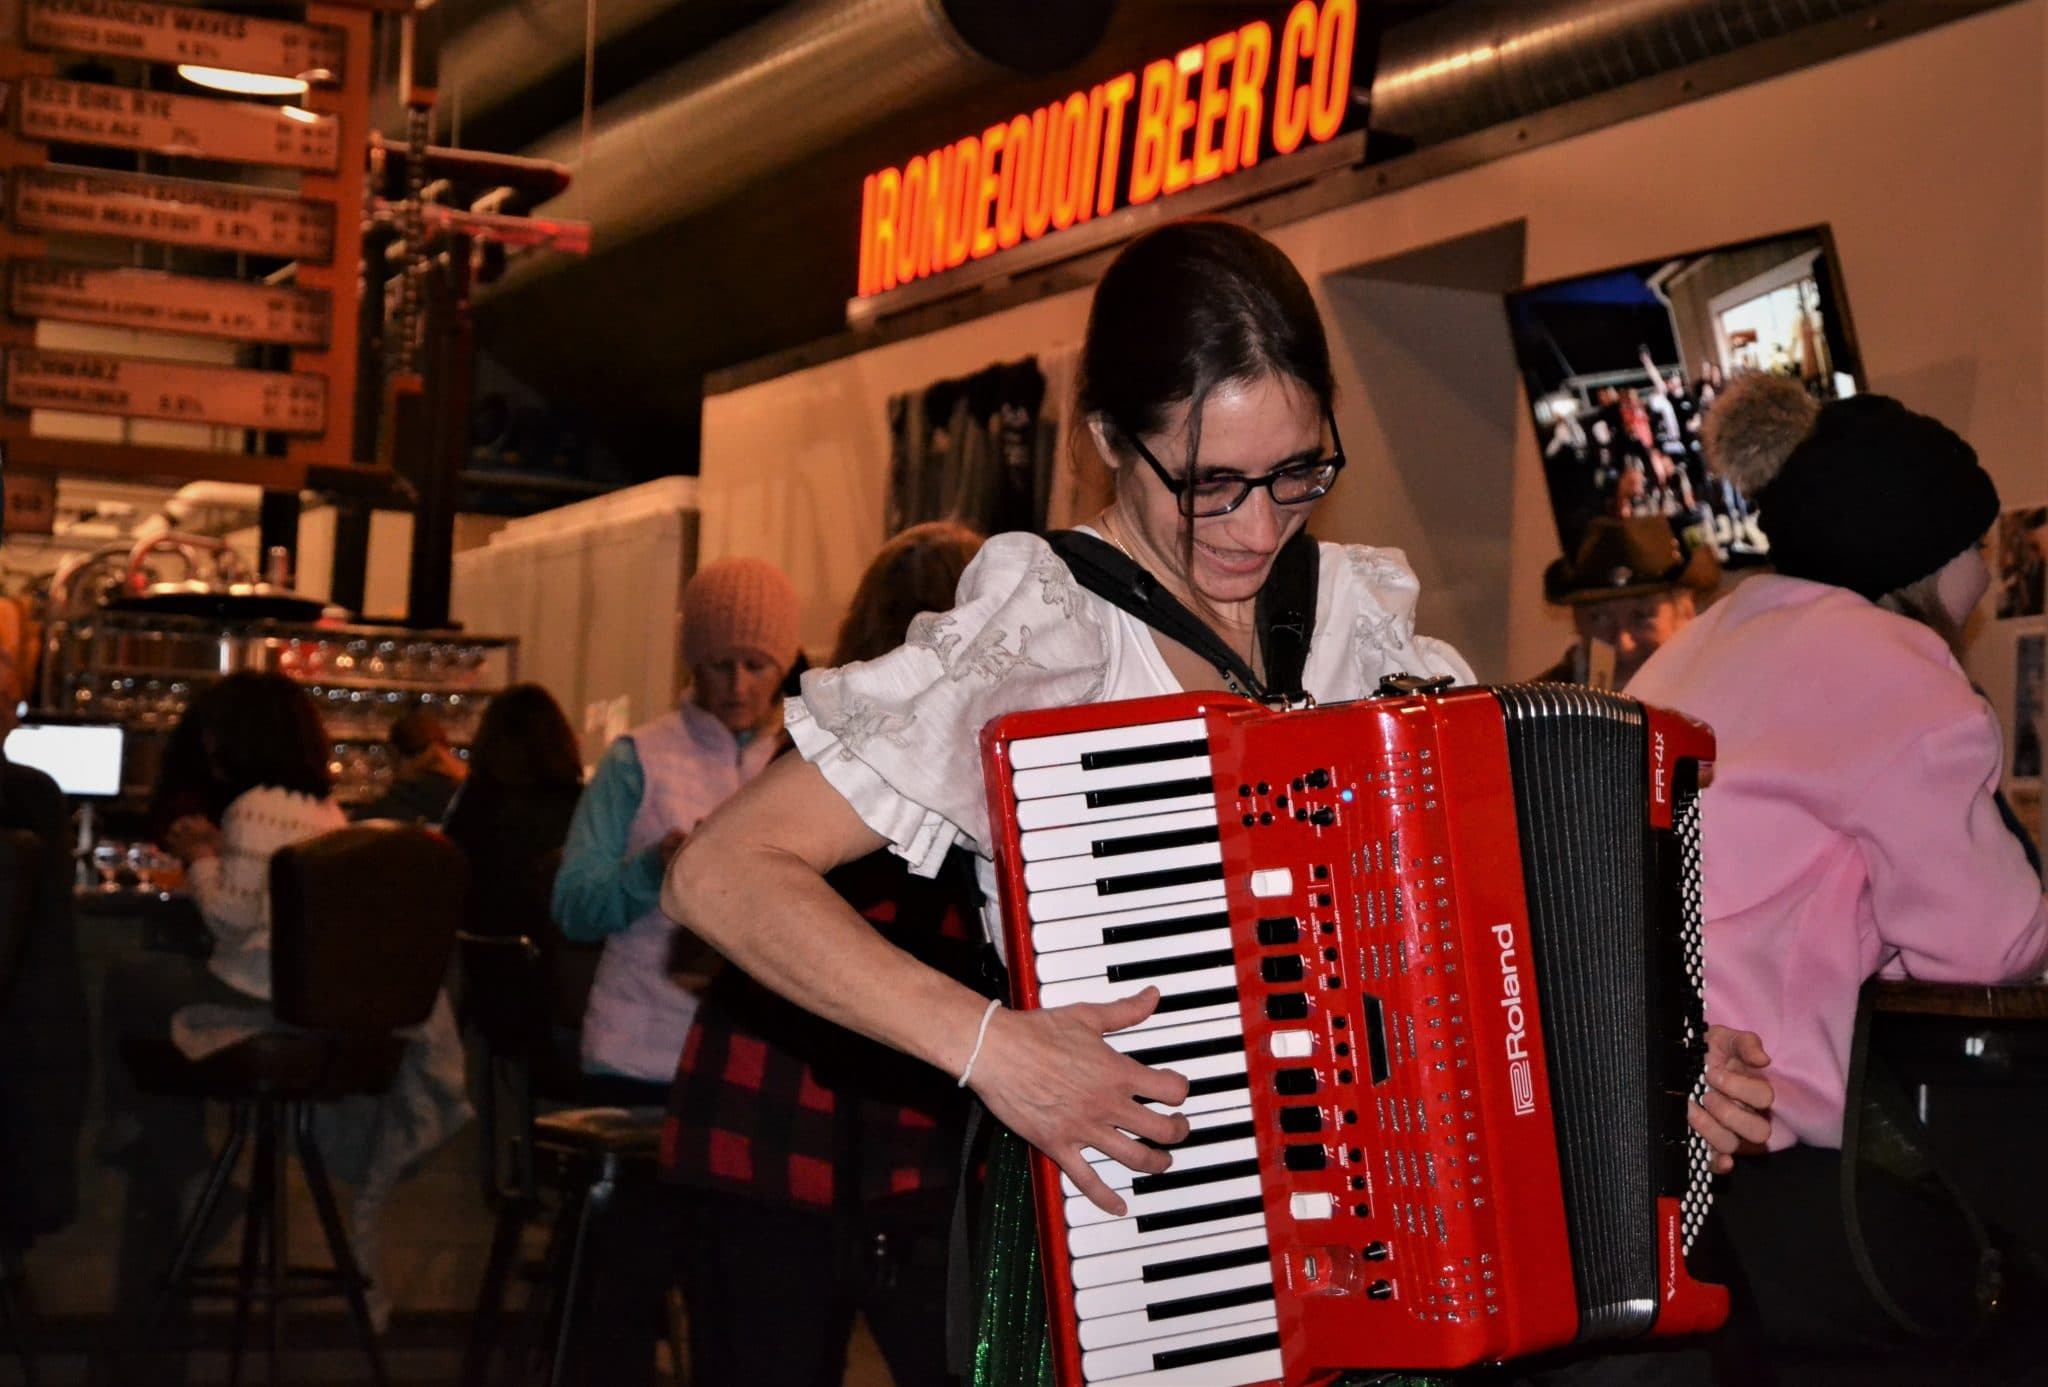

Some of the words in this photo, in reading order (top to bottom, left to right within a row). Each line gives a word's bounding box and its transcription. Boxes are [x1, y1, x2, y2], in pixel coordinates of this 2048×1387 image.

[173, 11, 247, 39] WAVES
[131, 92, 172, 120] RYE
[110, 118, 140, 138] ALE
[857, 71, 1136, 298] IRONDEQUOIT
[1128, 20, 1273, 205] BEER
[1272, 0, 1359, 156] CO
[16, 352, 120, 382] SCHWARZ
[1491, 921, 1528, 1061] Roland
[1666, 1215, 1676, 1303] V-Accordion
